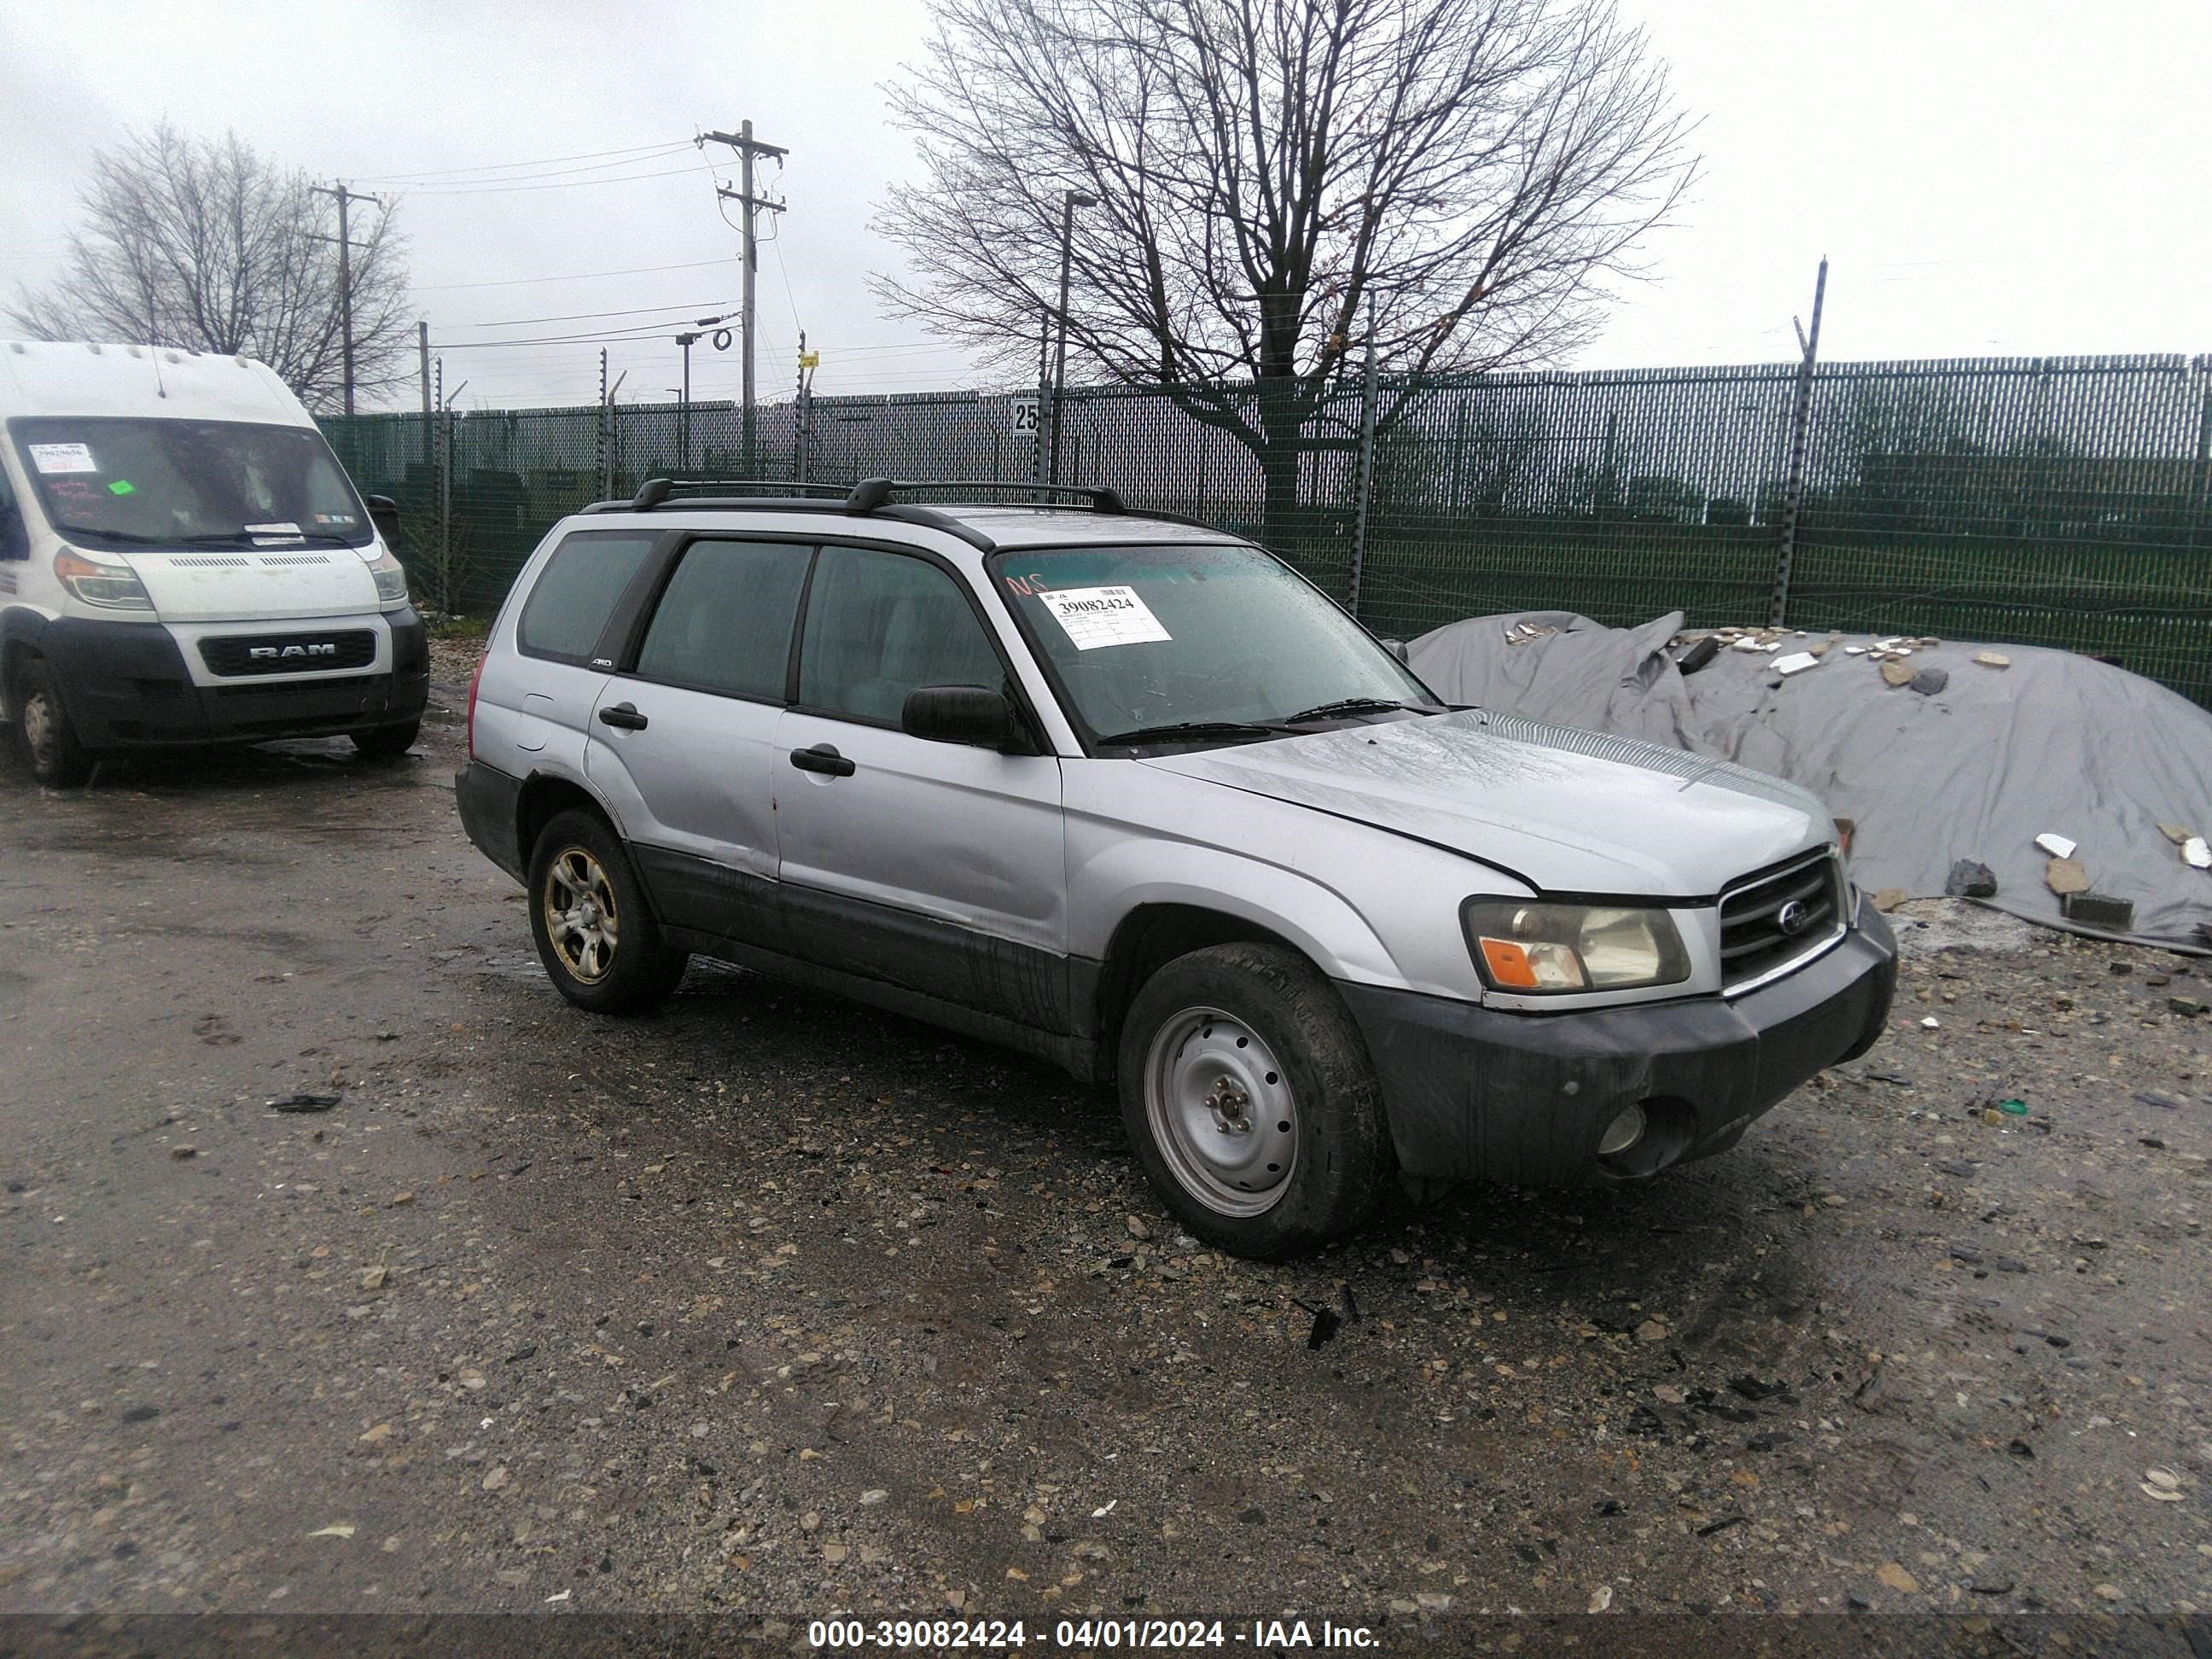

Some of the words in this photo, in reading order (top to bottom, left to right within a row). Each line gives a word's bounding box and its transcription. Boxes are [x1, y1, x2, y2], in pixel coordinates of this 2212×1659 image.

[1016, 405, 1037, 429] 25
[1058, 598, 1134, 614] 39082424
[250, 644, 335, 659] RAM
